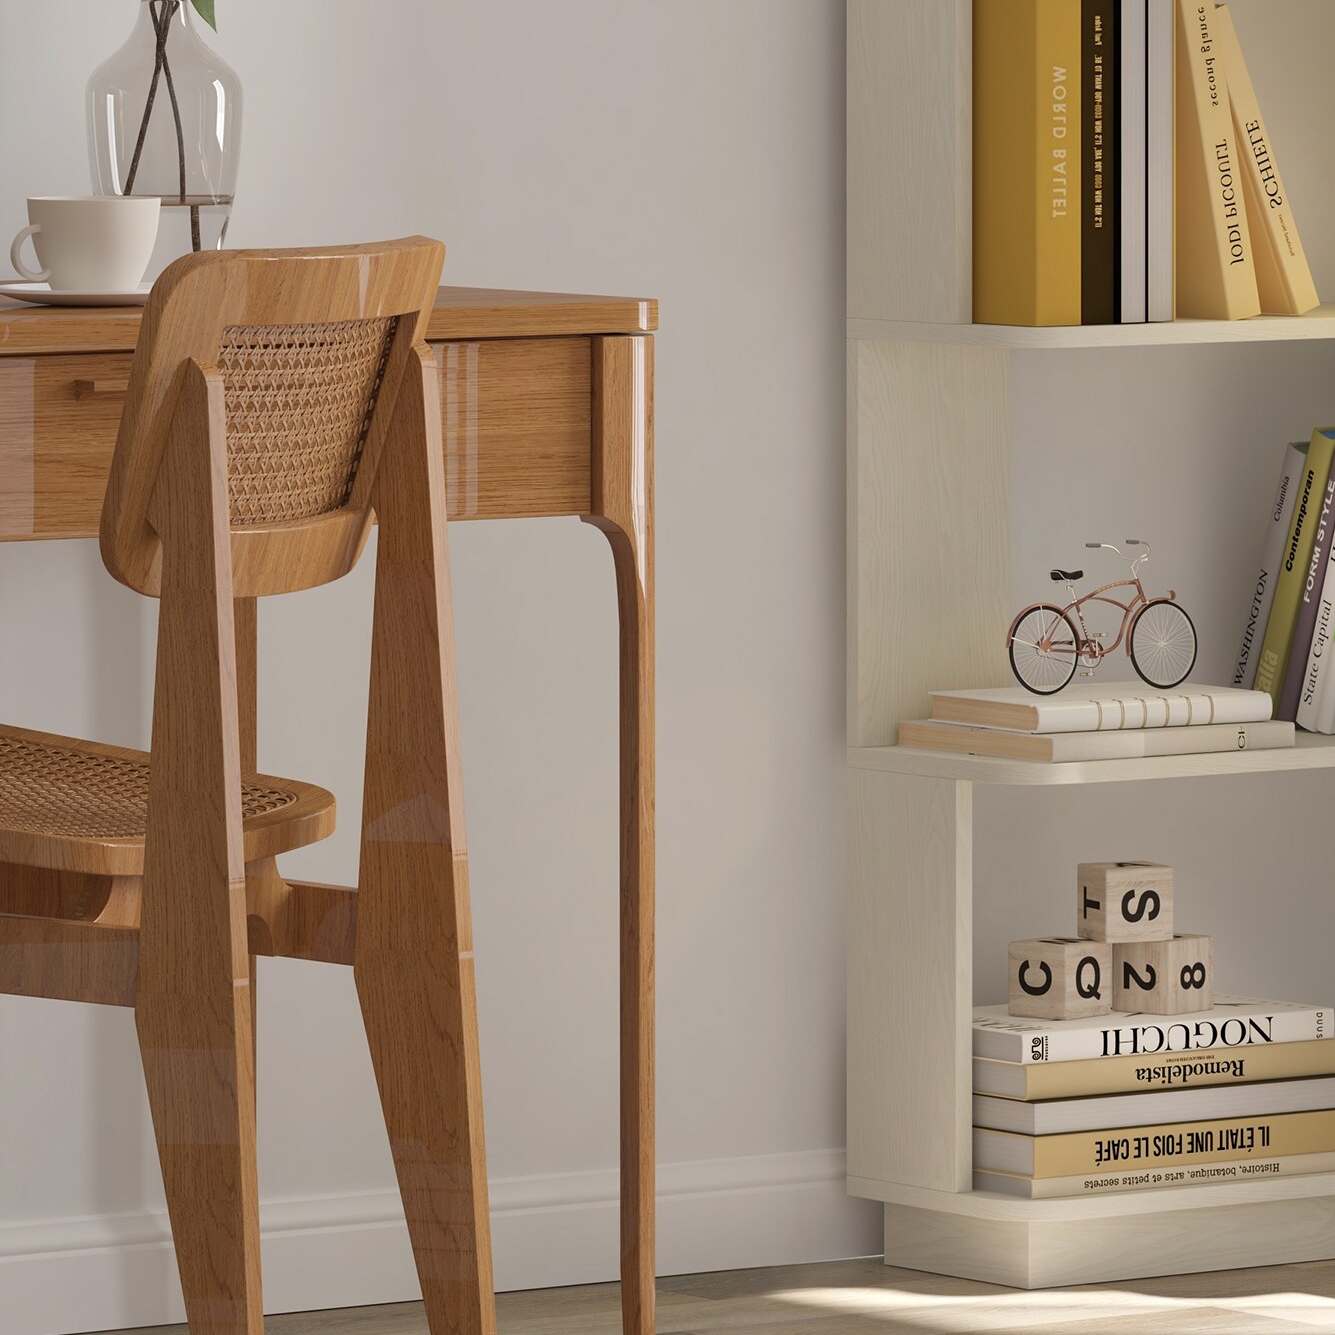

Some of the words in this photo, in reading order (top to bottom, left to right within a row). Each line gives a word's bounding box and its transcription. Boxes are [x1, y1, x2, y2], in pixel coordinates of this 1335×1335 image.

[1274, 475, 1290, 522] Columbia
[1286, 469, 1314, 572] Contemporan
[1304, 547, 1321, 603] FORM
[1317, 480, 1335, 541] STYLE
[1233, 569, 1268, 685] WASHINGTON
[1304, 662, 1319, 705] State
[1313, 599, 1332, 658] Capital
[1083, 886, 1100, 919] T
[1121, 889, 1160, 923] S
[1018, 960, 1052, 996] C
[1076, 956, 1101, 1000] Q
[1123, 961, 1157, 991] 2
[1180, 962, 1206, 990] 8
[1100, 1016, 1274, 1057] NOGUCHI
[1135, 1059, 1245, 1084] Remodelista
[1134, 1137, 1149, 1159] LE
[1153, 1134, 1183, 1156] FOIS
[1187, 1131, 1213, 1154] UNE
[1217, 1127, 1254, 1153] ÉTAIT
[1258, 1126, 1270, 1147] IL
[1095, 1139, 1129, 1167] CAFÉ
[1122, 1174, 1149, 1186] petits
[1152, 1174, 1162, 1182] et
[1165, 1172, 1185, 1181] arts
[1187, 1167, 1236, 1179] botanique,
[1239, 1163, 1280, 1174] Histoire,
[1084, 1178, 1119, 1189] secrets
